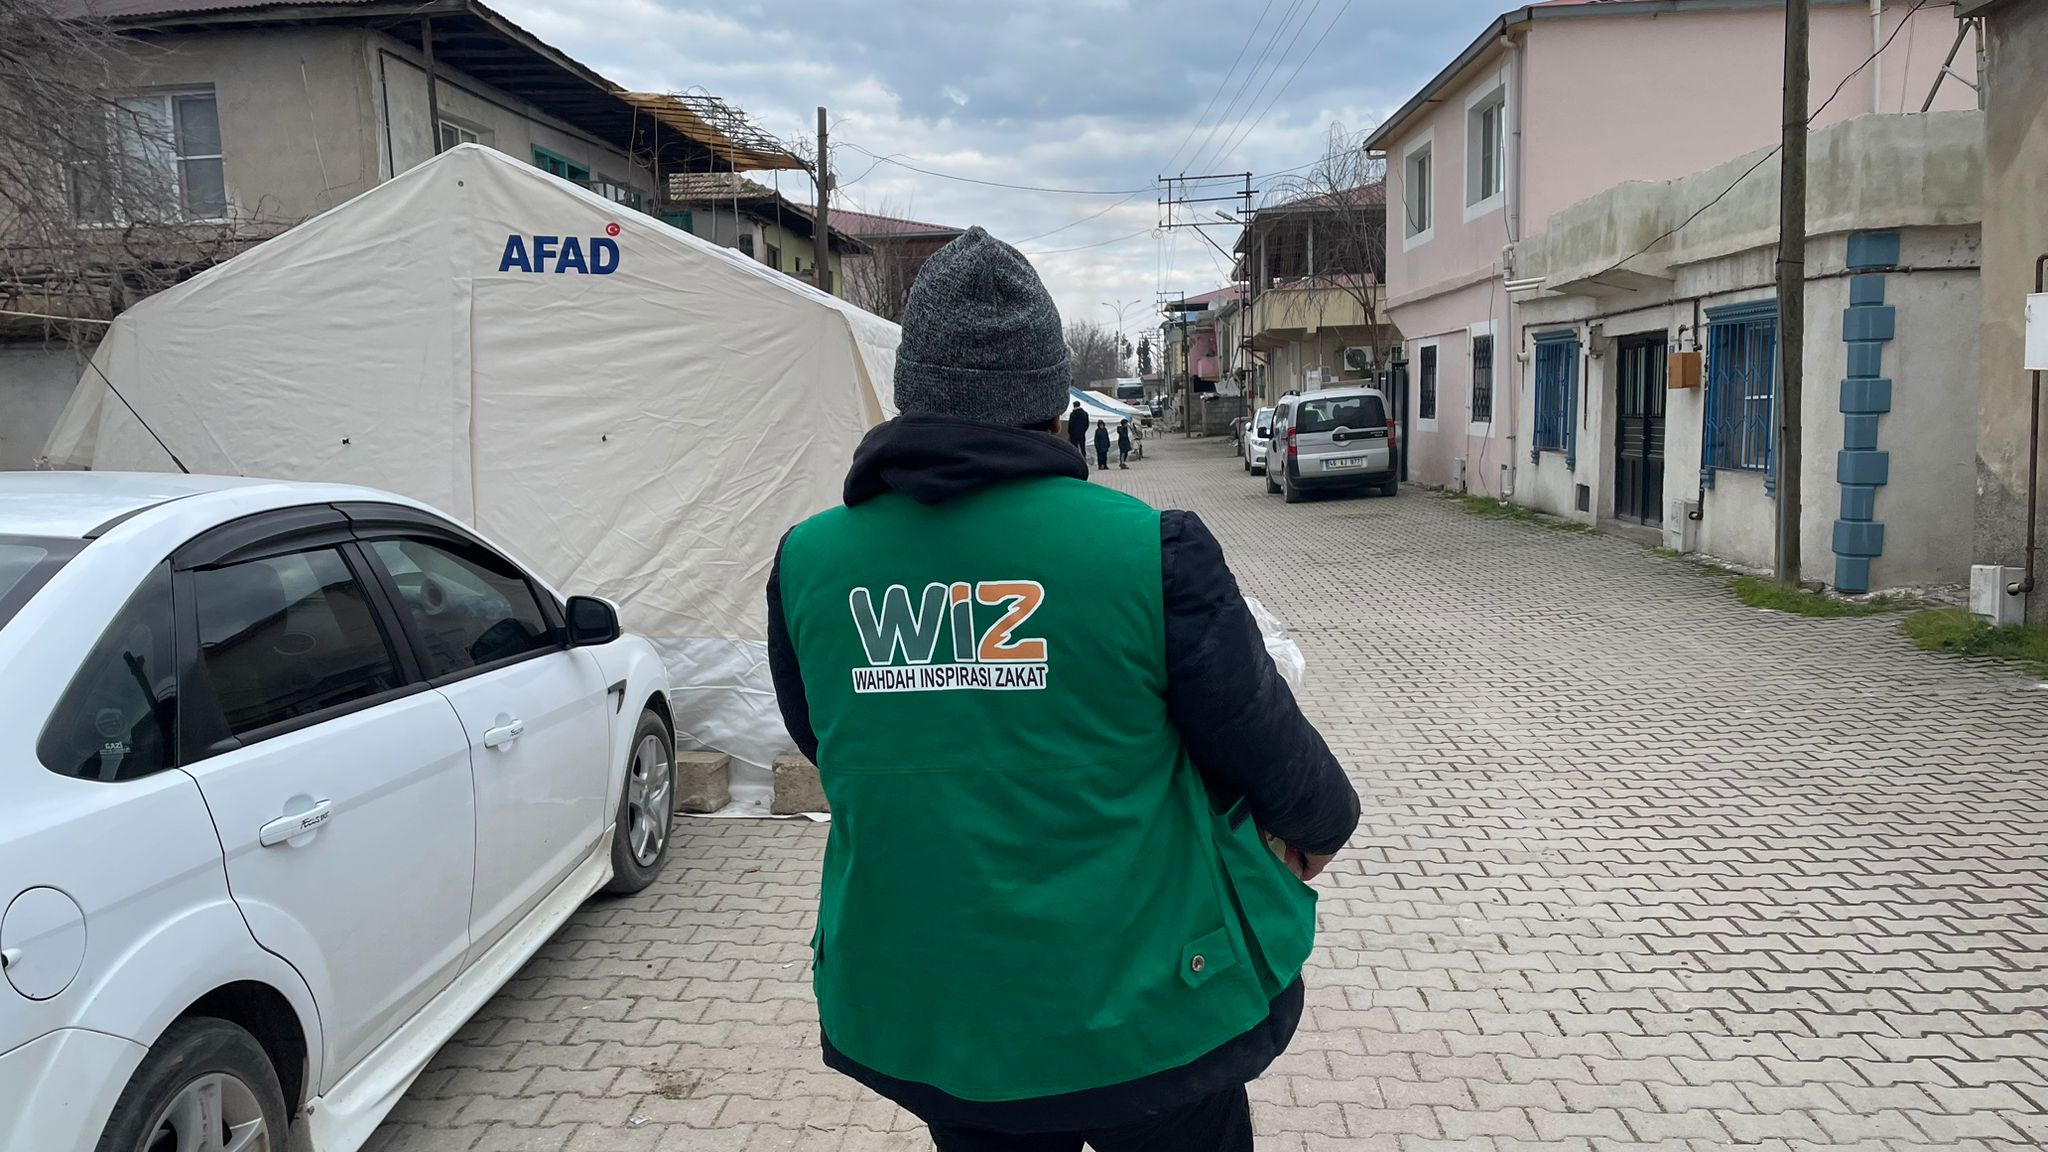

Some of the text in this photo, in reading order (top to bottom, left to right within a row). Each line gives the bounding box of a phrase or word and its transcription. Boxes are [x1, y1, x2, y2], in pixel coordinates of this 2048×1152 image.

[498, 234, 620, 275] AFAD
[854, 666, 1046, 690] WAHDAH INSPIRASI ZAKAT
